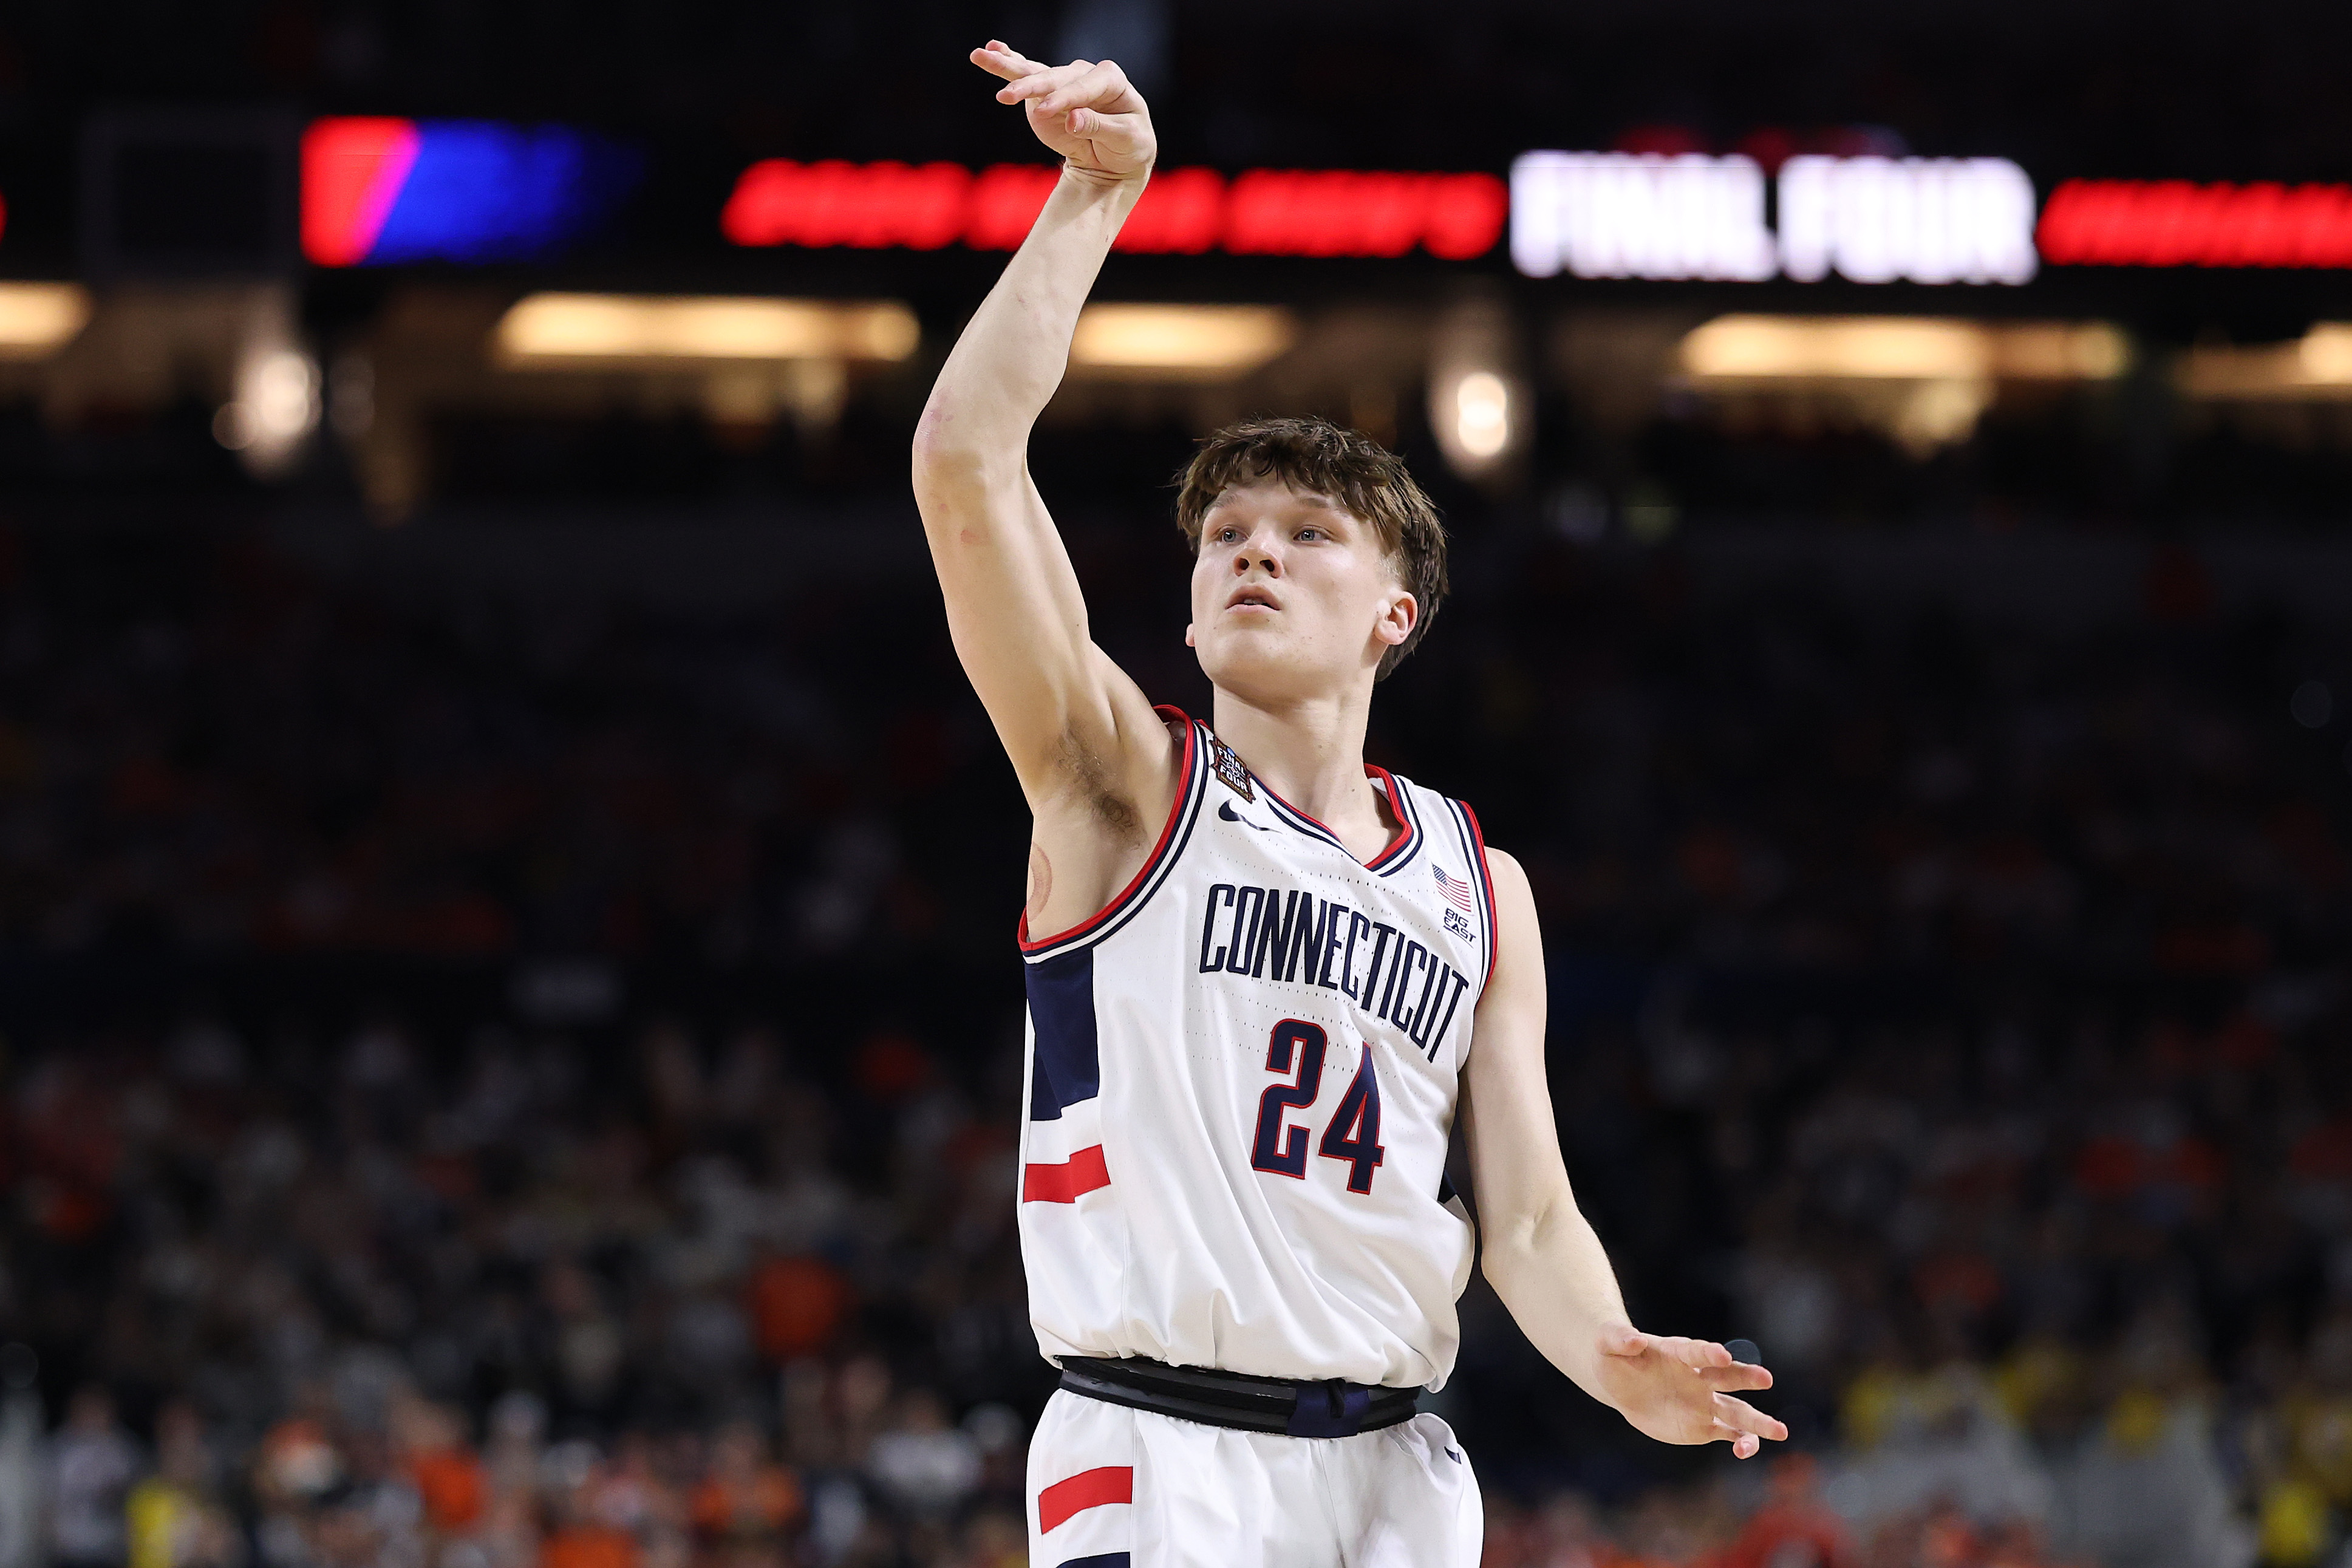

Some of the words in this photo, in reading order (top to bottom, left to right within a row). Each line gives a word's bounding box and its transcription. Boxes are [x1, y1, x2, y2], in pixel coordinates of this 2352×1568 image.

[1510, 151, 1776, 281] FINAL
[1778, 155, 2038, 284] FOUR
[1217, 746, 1246, 776] FINAL
[1220, 765, 1249, 792] FOUR
[1444, 916, 1476, 942] EAST
[1445, 907, 1469, 928] BIG
[1199, 884, 1469, 1063] CONNECTICUT
[1251, 1018, 1385, 1195] 24
